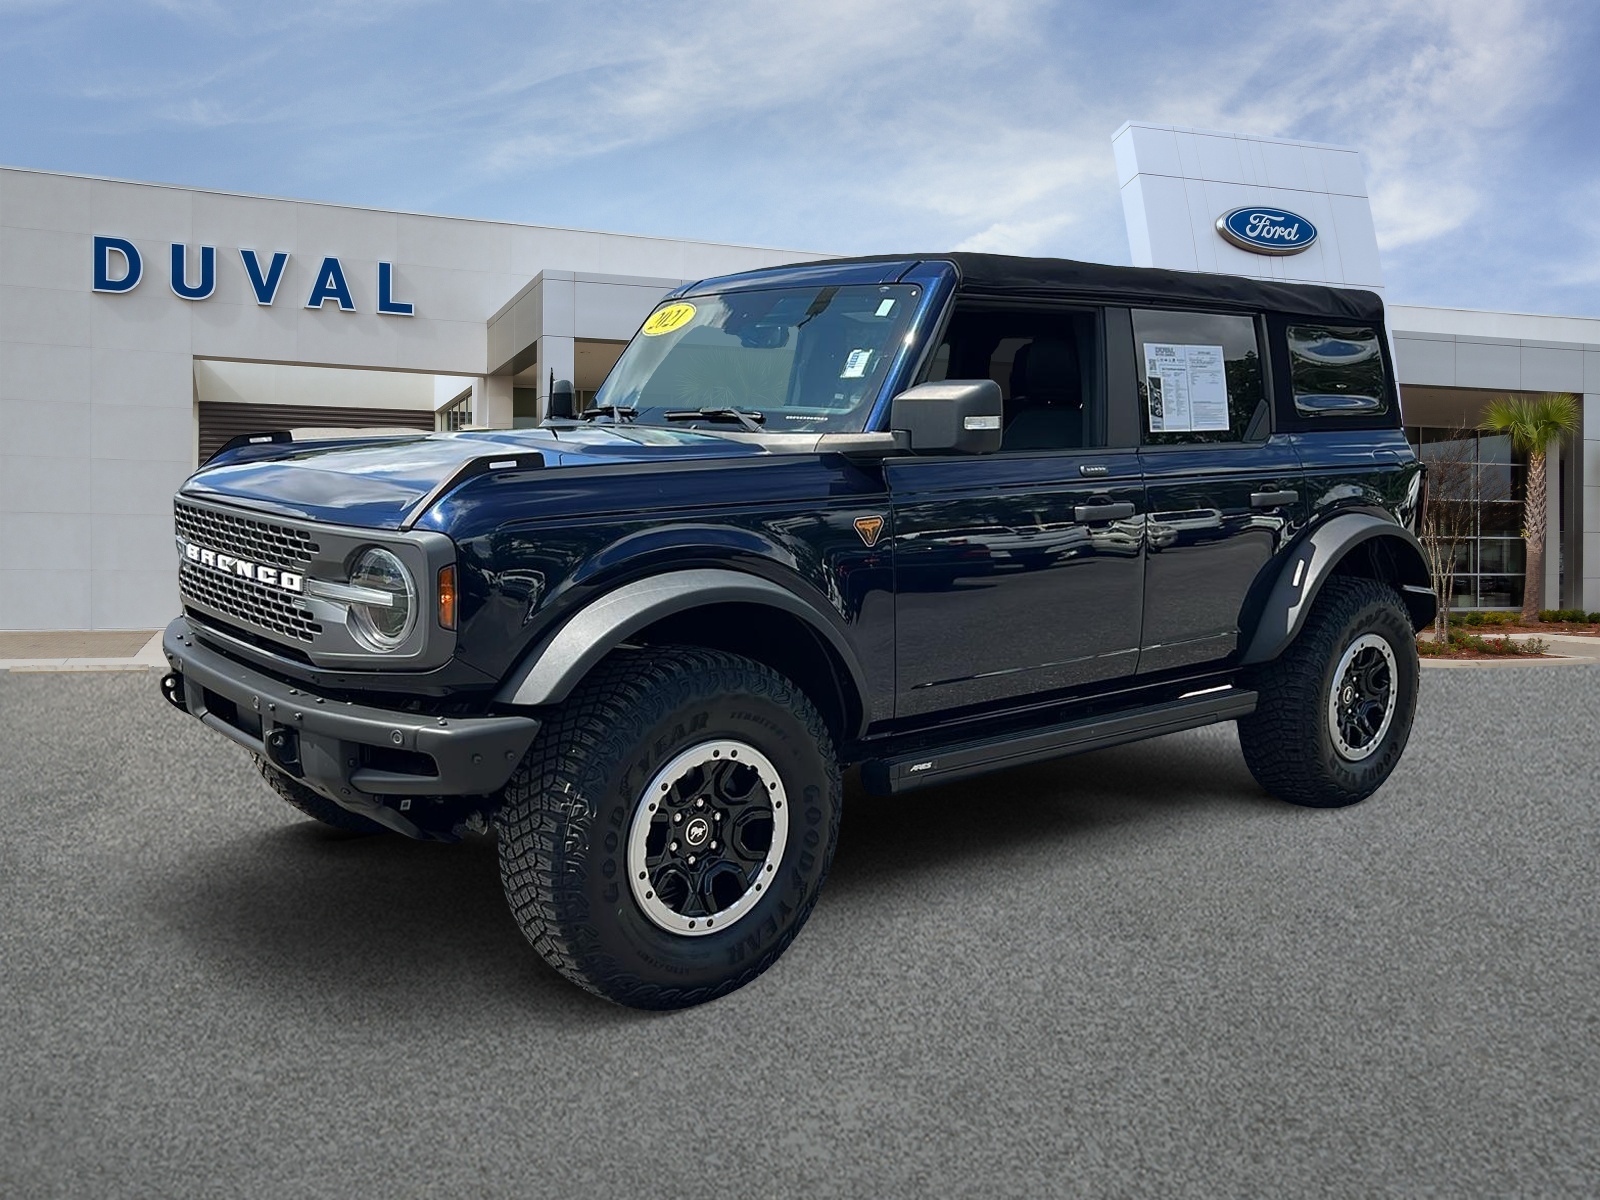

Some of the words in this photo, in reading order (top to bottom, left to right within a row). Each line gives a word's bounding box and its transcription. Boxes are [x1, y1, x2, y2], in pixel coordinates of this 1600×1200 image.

[1245, 213, 1300, 241] Ford
[92, 235, 415, 317] DUVAL
[647, 308, 690, 330] 2021
[186, 543, 304, 592] BRONCO
